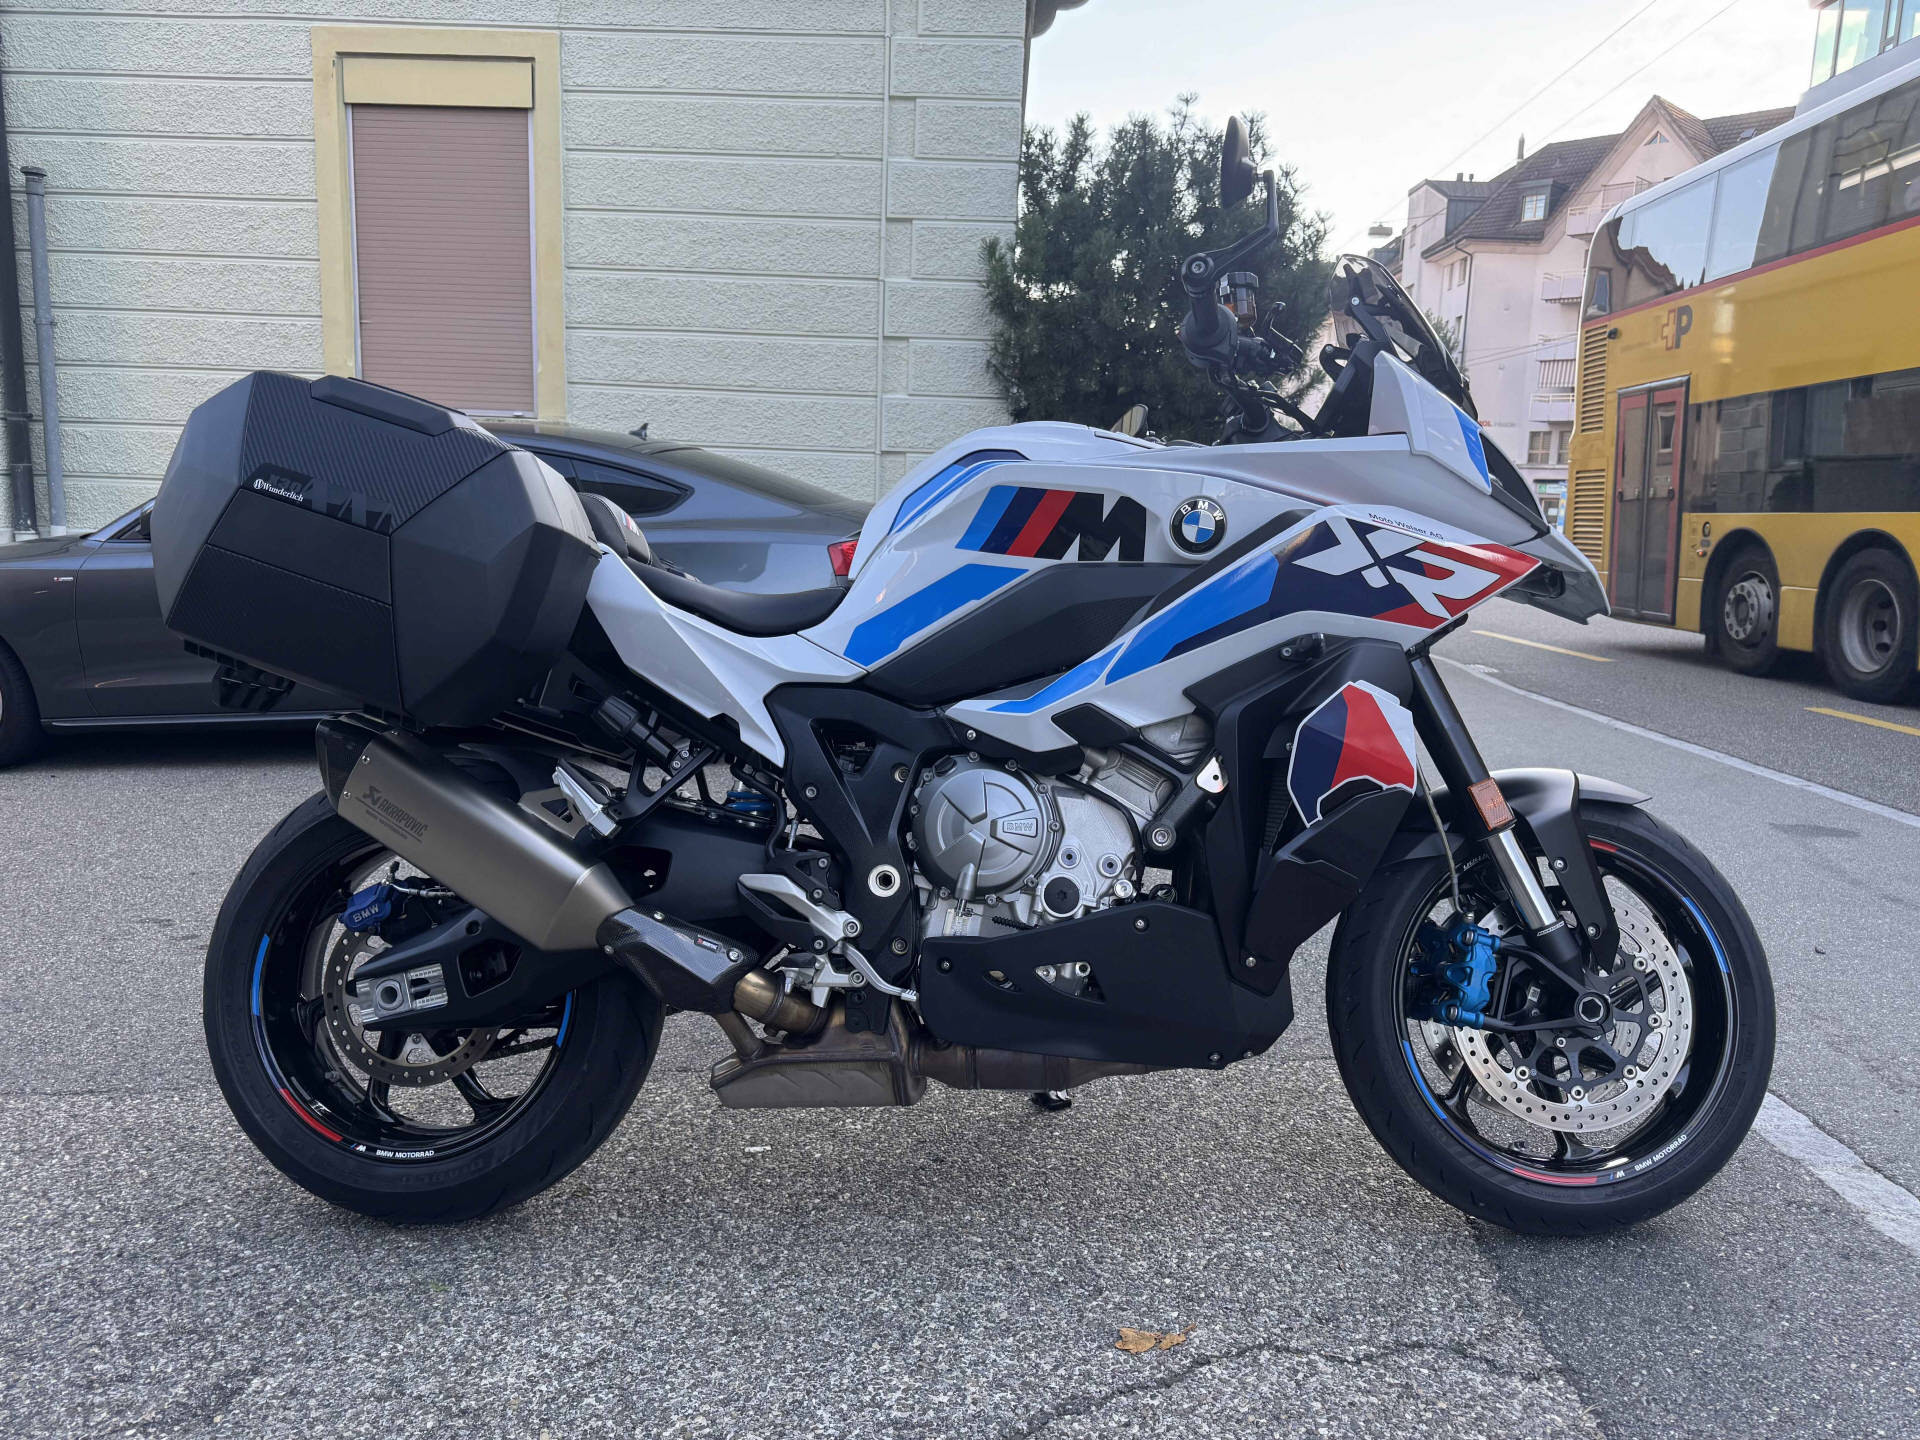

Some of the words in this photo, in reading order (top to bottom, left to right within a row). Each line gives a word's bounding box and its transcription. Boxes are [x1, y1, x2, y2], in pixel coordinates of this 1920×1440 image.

[262, 482, 304, 502] Wunderlich
[1180, 500, 1224, 521] BMW
[1368, 513, 1394, 525] Moto
[1032, 491, 1148, 562] M
[1291, 516, 1501, 620] XR
[1006, 822, 1034, 832] BMW
[352, 903, 379, 923] BMW
[376, 1149, 394, 1158] BMW
[394, 1150, 435, 1159] MOTORRAD
[1634, 1158, 1653, 1172] BMW
[1652, 1134, 1687, 1163] MOTORRAD
